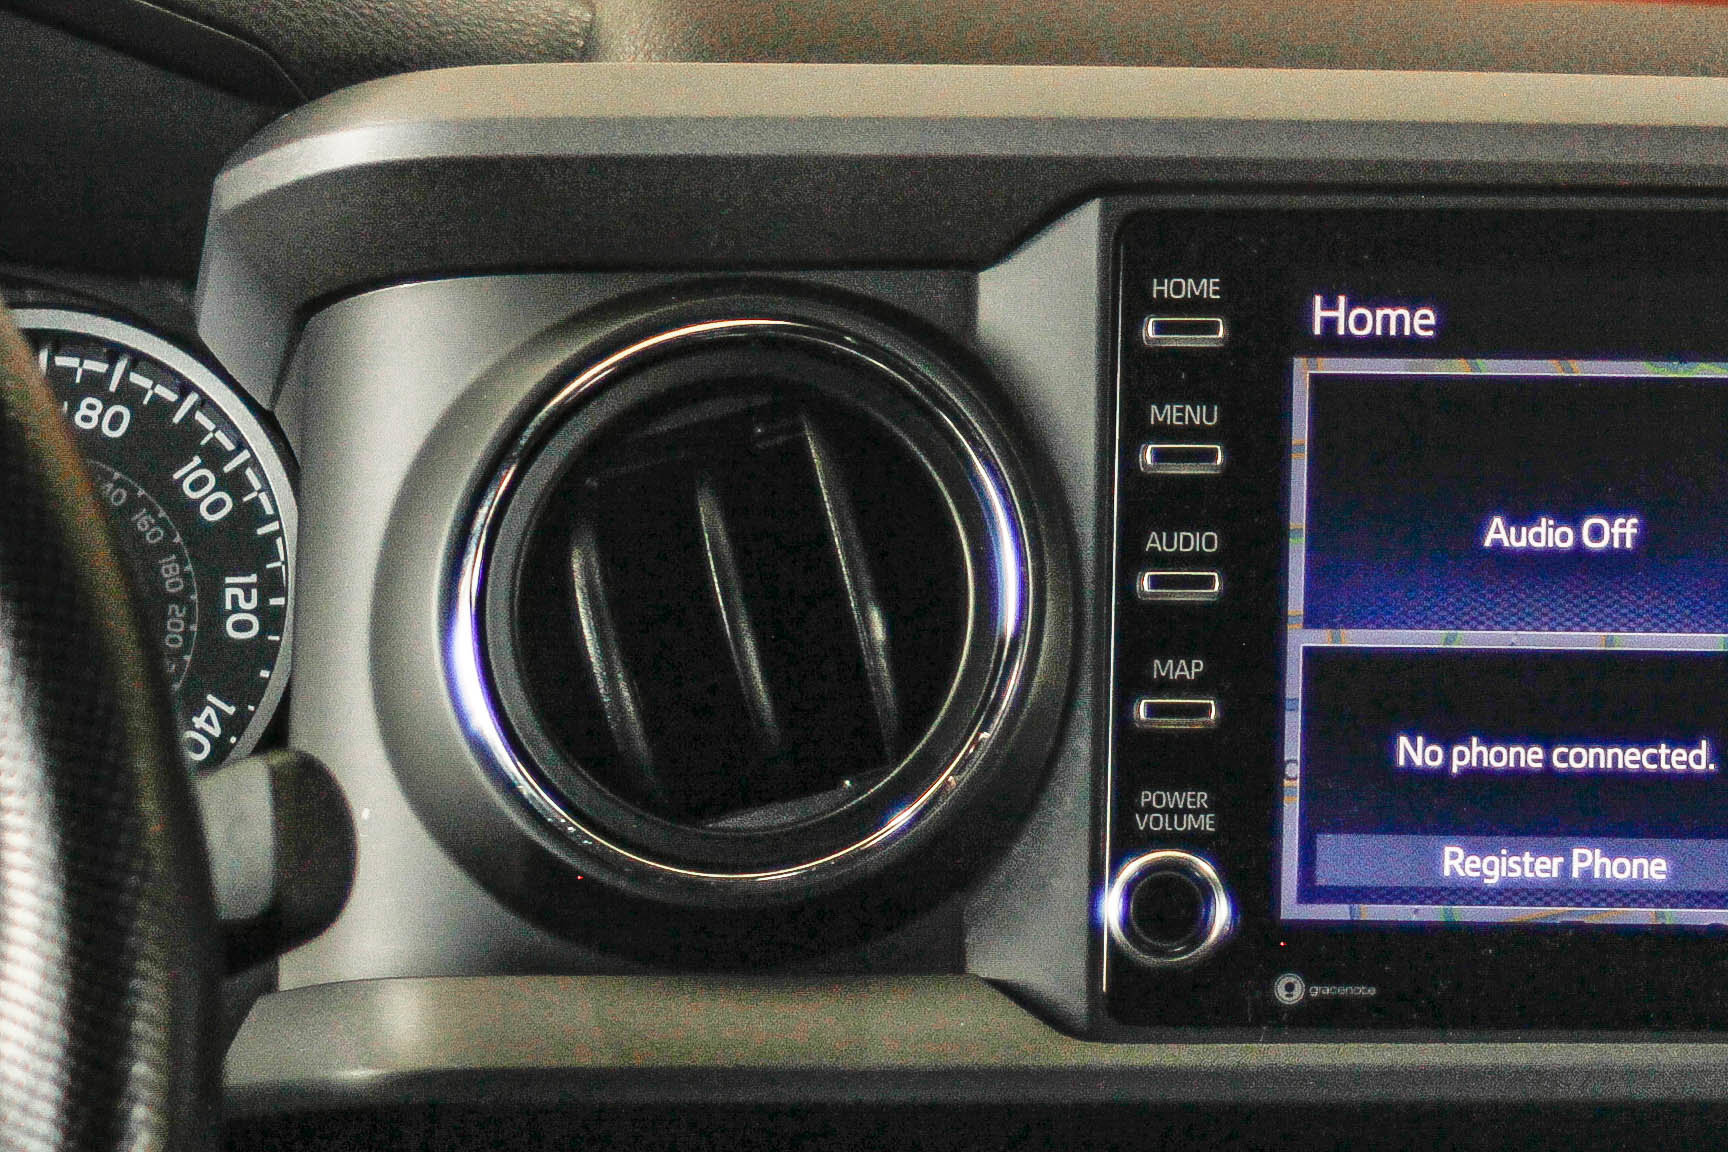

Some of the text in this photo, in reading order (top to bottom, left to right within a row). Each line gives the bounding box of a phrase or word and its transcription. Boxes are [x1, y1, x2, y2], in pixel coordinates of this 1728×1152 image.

[1152, 277, 1221, 300] HOME
[1312, 294, 1437, 338] Home
[73, 396, 131, 439] 80
[1150, 403, 1219, 427] MENU
[172, 454, 234, 522] 100
[130, 507, 164, 545] 160
[1145, 531, 1219, 553] AUDIO
[1483, 515, 1639, 550] Audio Off
[157, 553, 184, 594] 180
[164, 602, 187, 649] 200
[224, 573, 260, 640] 120
[1152, 658, 1205, 680] MAP
[182, 692, 237, 762] 140
[1397, 735, 1716, 775] No phone connected.
[1140, 790, 1209, 810] POWER
[1134, 812, 1216, 832] VOLUME
[1442, 844, 1669, 885] Register Phone
